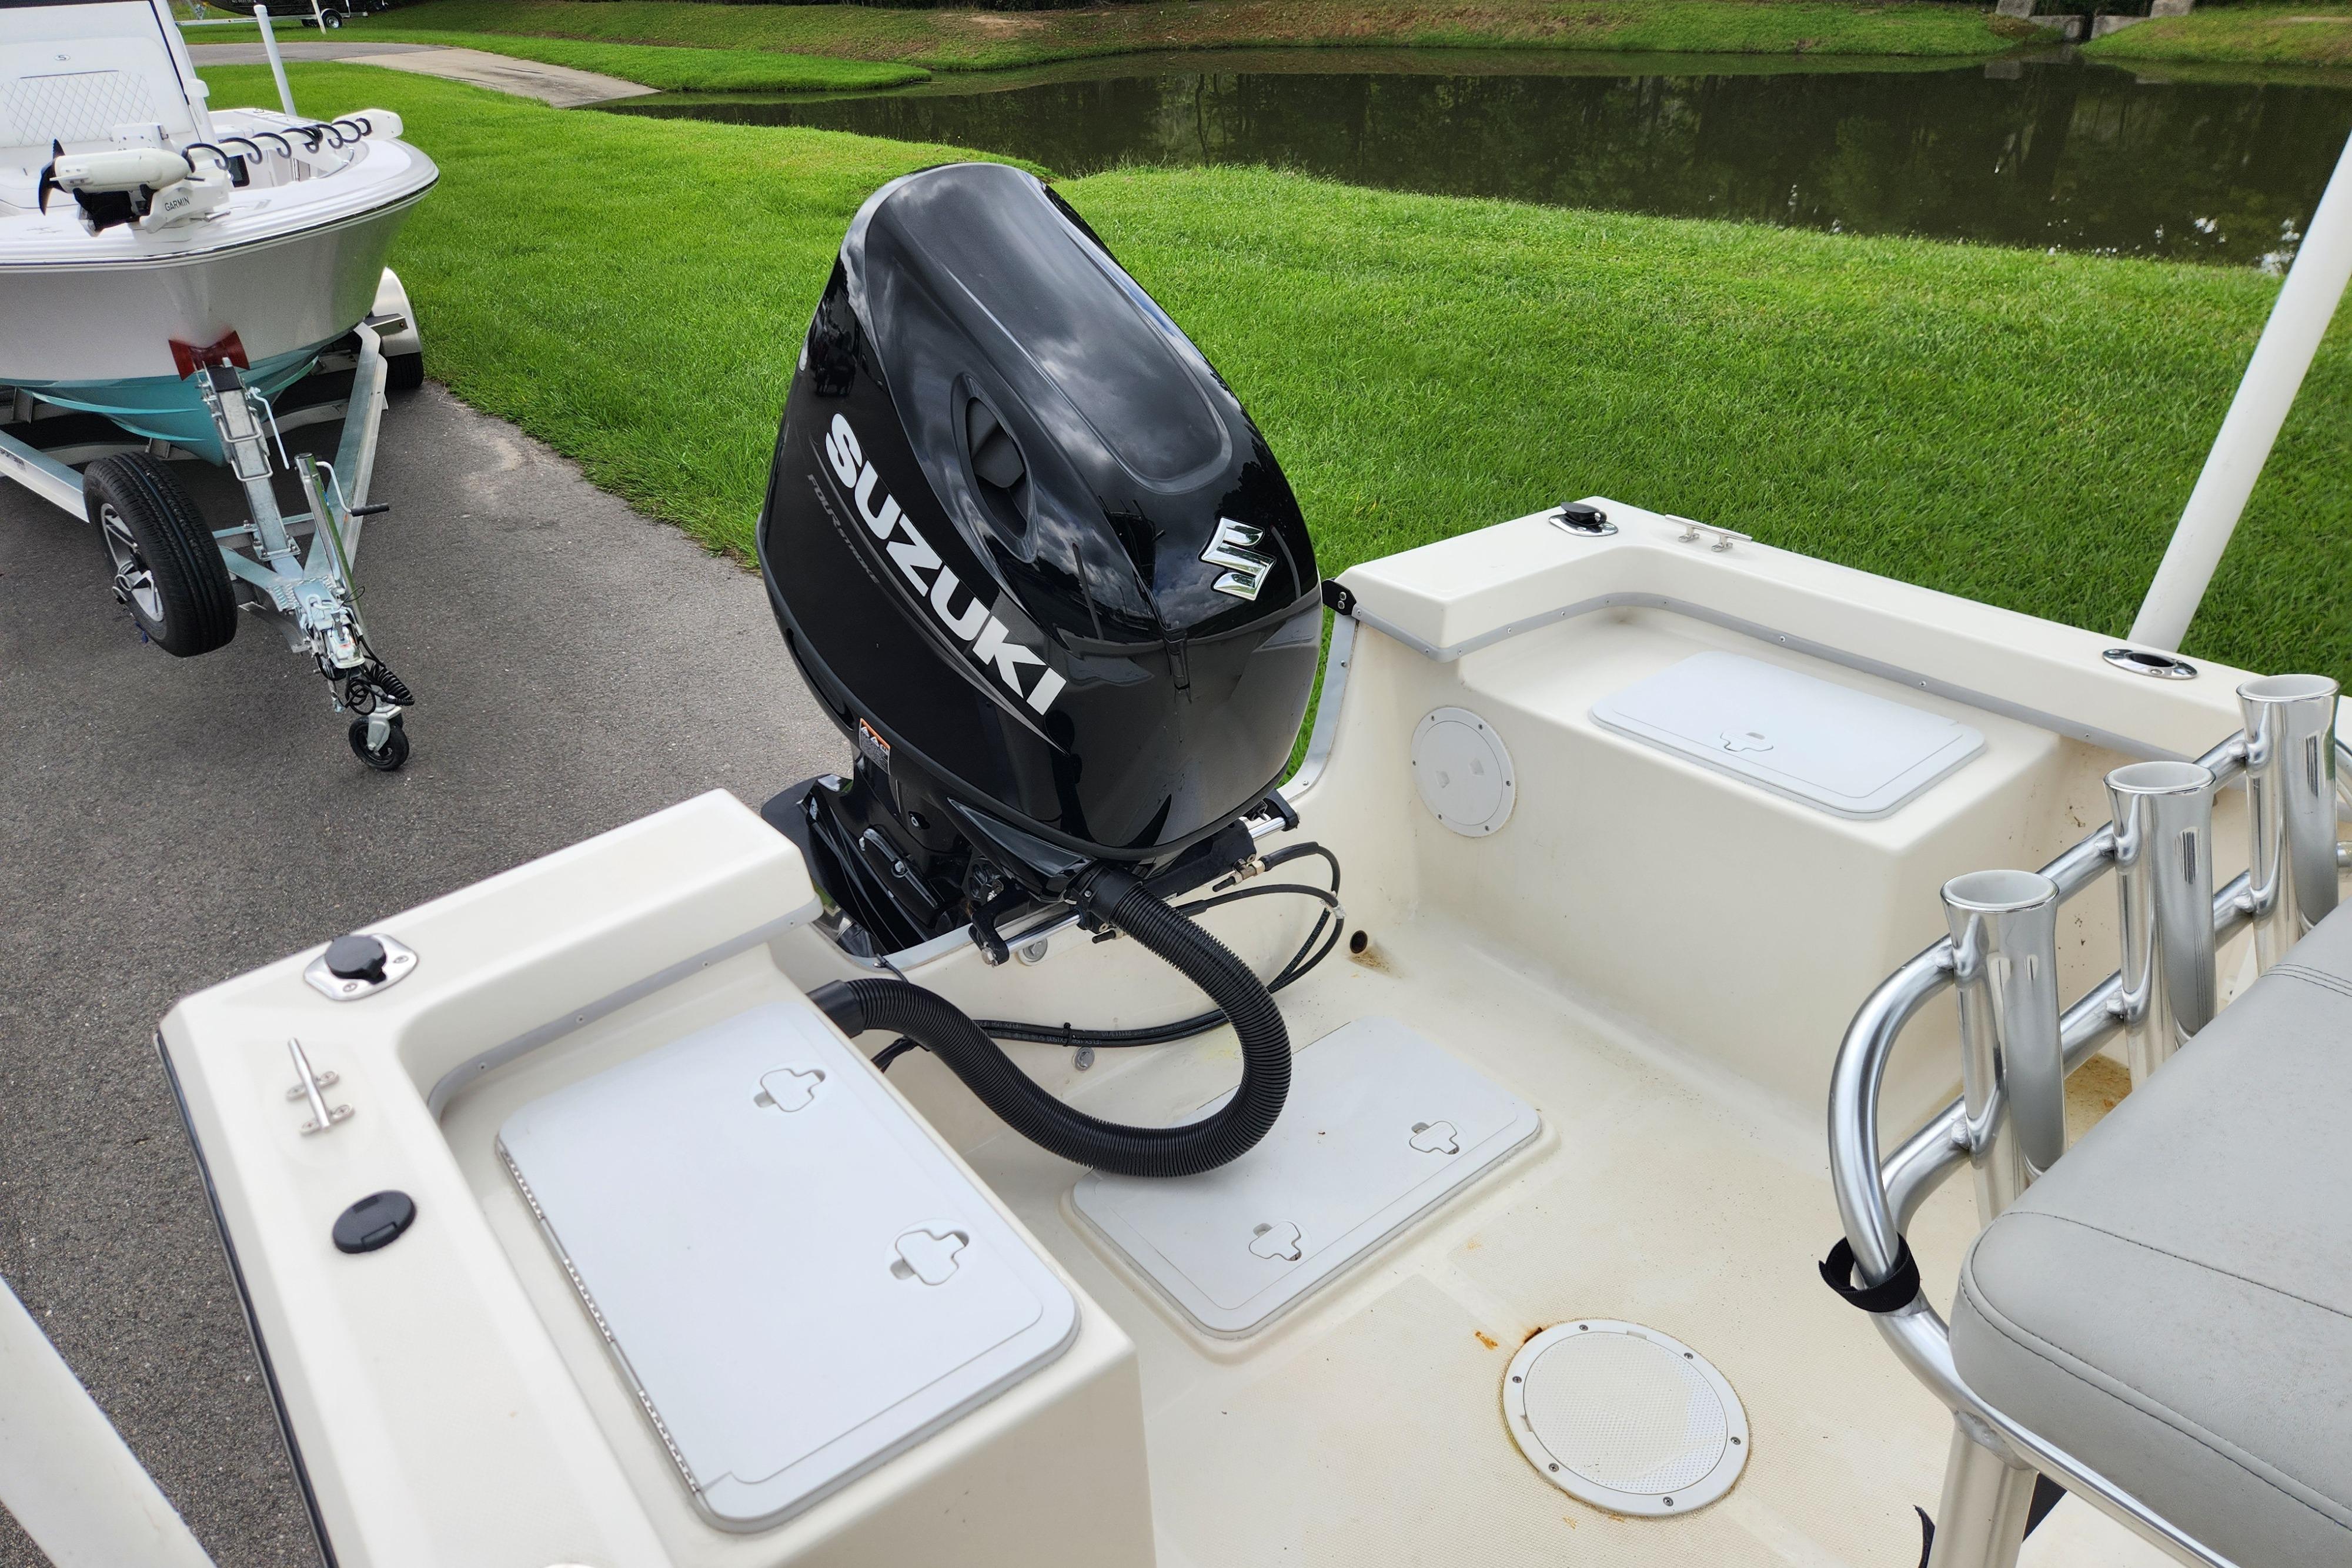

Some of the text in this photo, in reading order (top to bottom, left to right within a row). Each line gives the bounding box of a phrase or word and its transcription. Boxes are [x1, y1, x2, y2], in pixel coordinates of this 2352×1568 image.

[164, 196, 191, 212] GARMIN
[807, 474, 880, 584] FOUR STROKE
[826, 413, 1067, 716] SUZUKI
